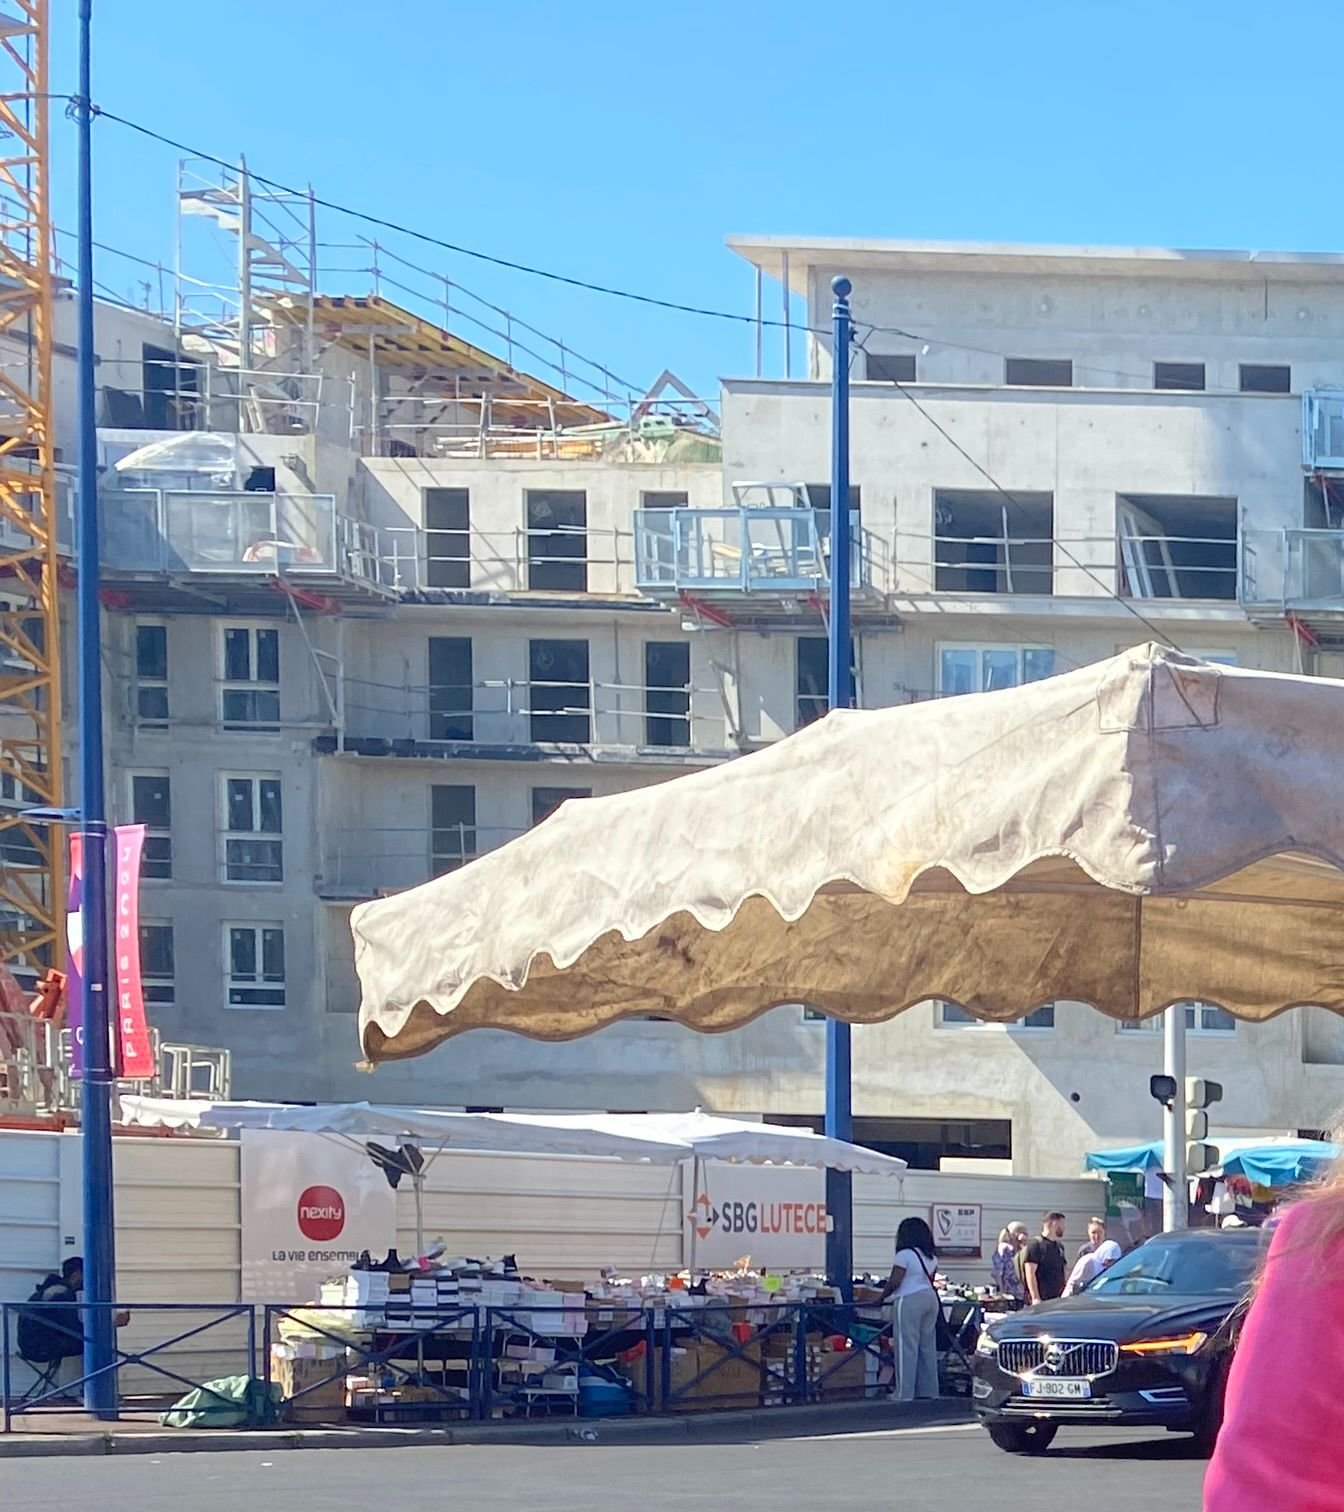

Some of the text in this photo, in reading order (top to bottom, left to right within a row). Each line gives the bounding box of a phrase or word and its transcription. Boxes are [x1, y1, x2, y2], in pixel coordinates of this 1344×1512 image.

[300, 1206, 342, 1220] nexity
[721, 1202, 826, 1234] SBG LUTECE
[288, 1250, 305, 1262] vie
[308, 1250, 359, 1262] ensembl
